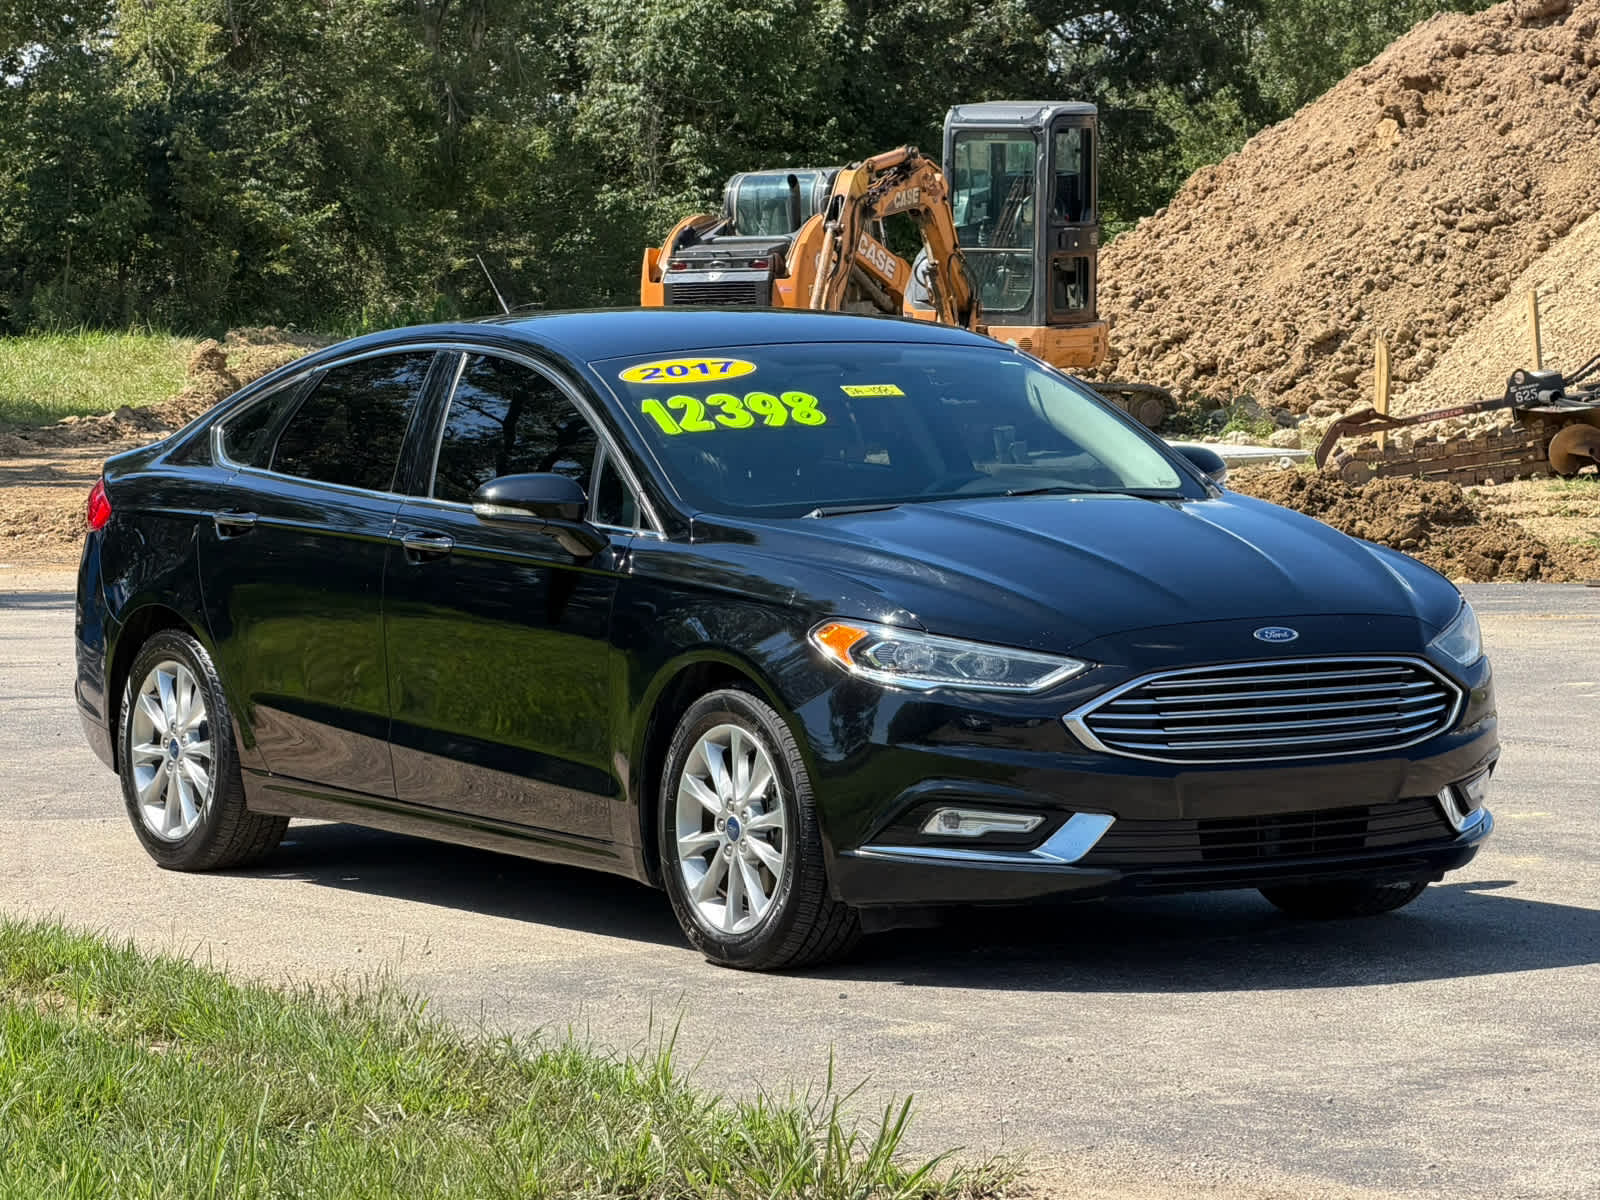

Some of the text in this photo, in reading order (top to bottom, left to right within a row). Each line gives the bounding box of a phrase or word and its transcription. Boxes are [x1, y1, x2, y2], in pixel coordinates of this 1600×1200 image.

[894, 187, 921, 209] CASE
[858, 232, 897, 280] CASE
[640, 361, 735, 380] 2017
[1514, 388, 1538, 404] 625
[641, 391, 827, 435] 12398
